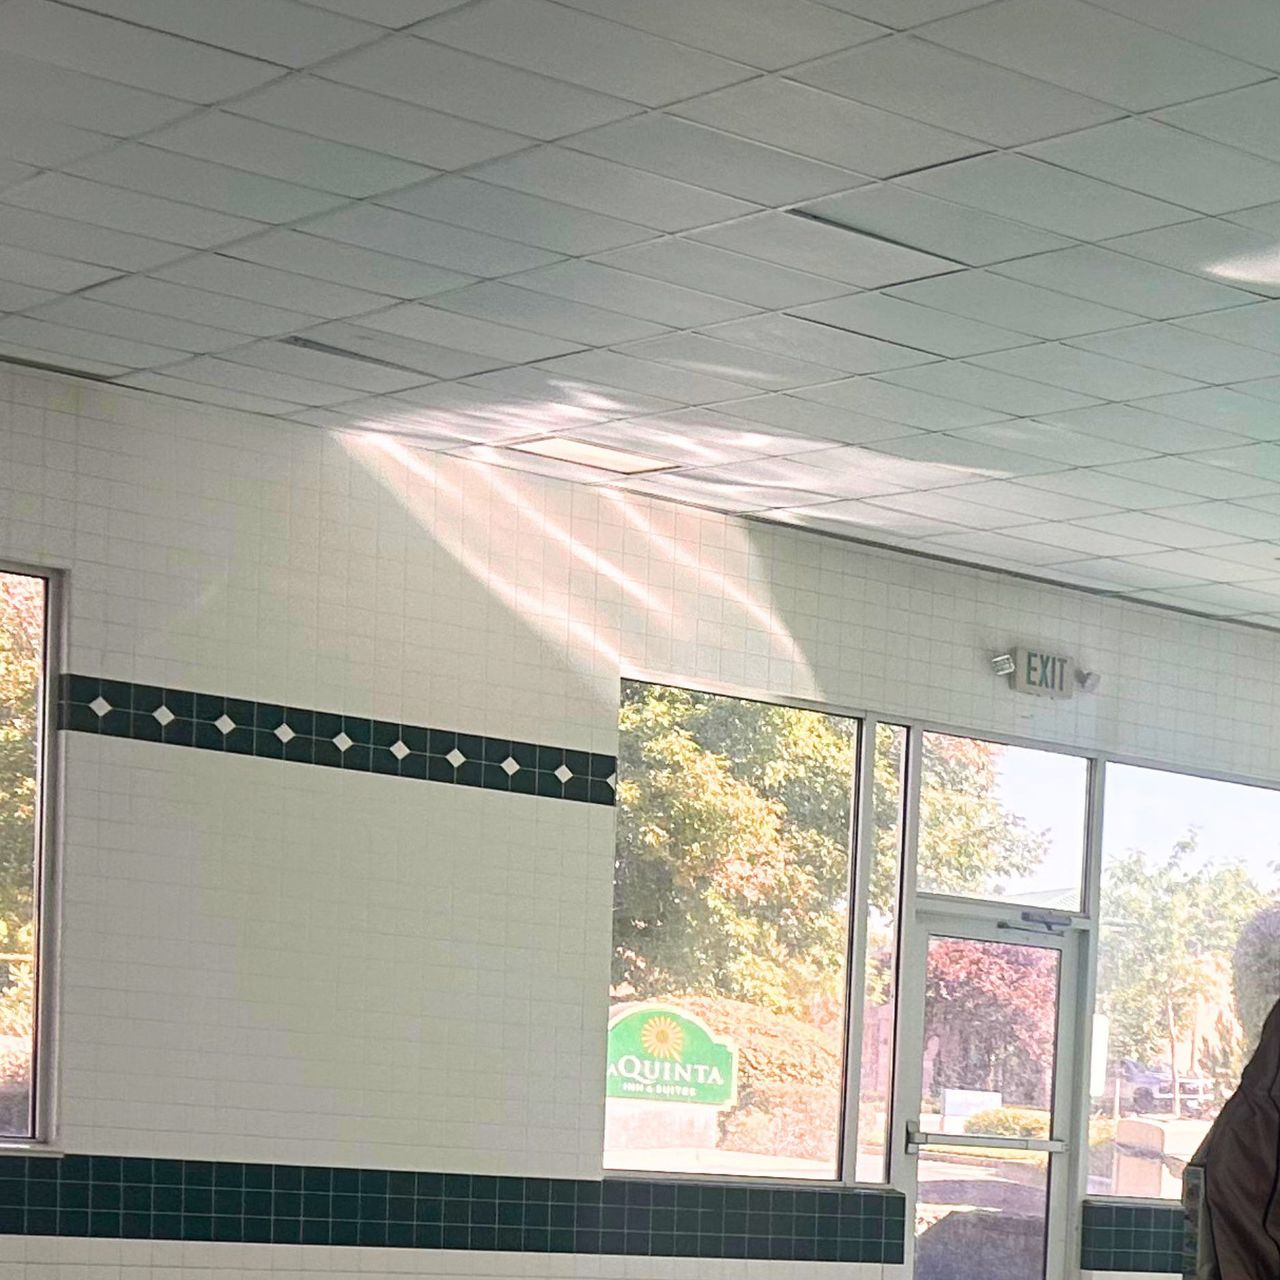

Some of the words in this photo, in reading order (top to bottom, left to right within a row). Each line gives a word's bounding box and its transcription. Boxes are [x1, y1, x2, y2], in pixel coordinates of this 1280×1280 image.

[1026, 651, 1068, 691] EXIT
[607, 1064, 618, 1077] A
[618, 1055, 724, 1085] QUINTA
